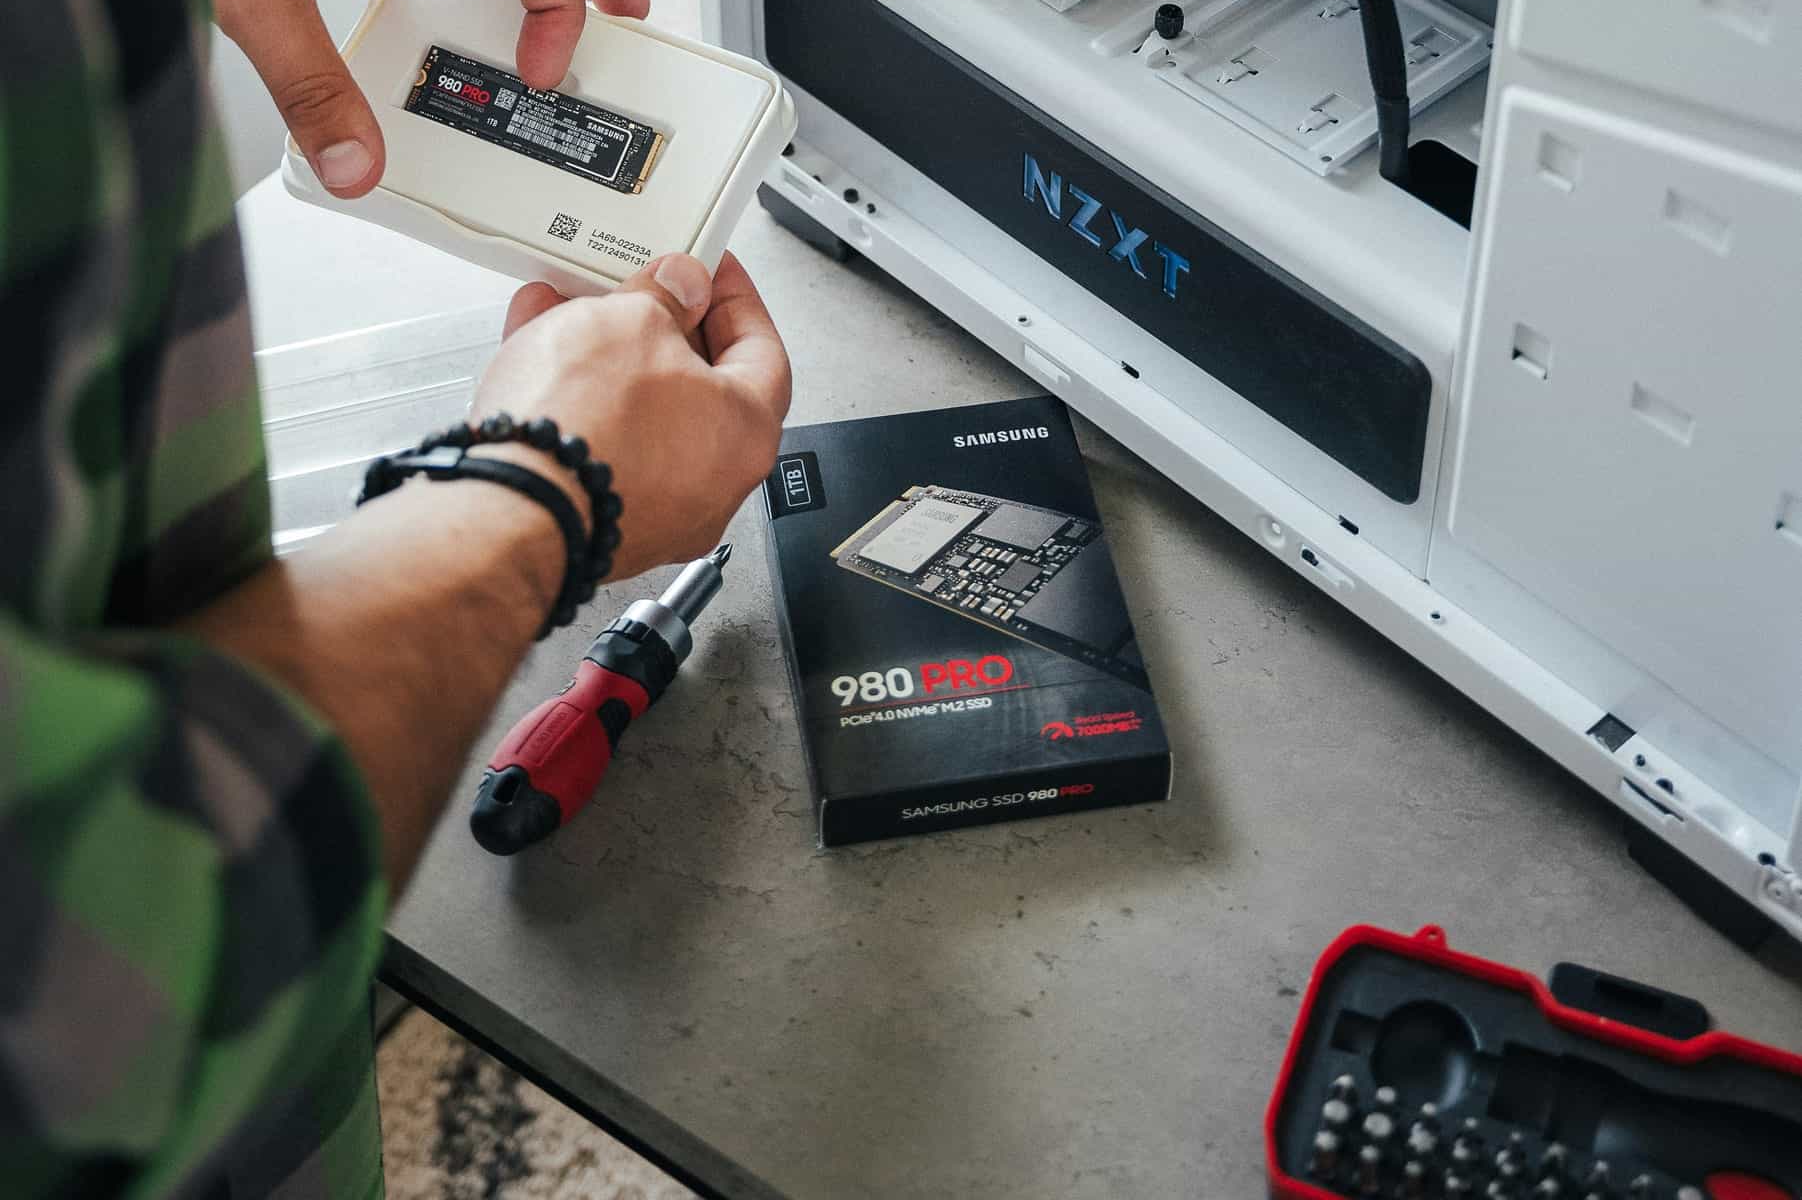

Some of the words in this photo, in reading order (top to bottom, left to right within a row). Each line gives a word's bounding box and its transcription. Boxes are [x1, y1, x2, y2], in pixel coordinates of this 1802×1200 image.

[438, 74, 462, 93] 980
[461, 83, 491, 104] PRO
[470, 76, 484, 87] SSD
[486, 117, 498, 127] 1TB
[586, 121, 625, 142] SAMSUNG
[1023, 151, 1191, 299] NZXT
[952, 426, 1050, 448] SAMSUNG
[786, 468, 806, 497] 1TB
[831, 667, 915, 707] 980
[919, 654, 1015, 695] PRO
[967, 697, 993, 710] SSD
[902, 798, 989, 819] SAMSUNG
[992, 793, 1025, 807] SSD
[1027, 788, 1058, 801] 980
[1059, 783, 1095, 796] PRO
